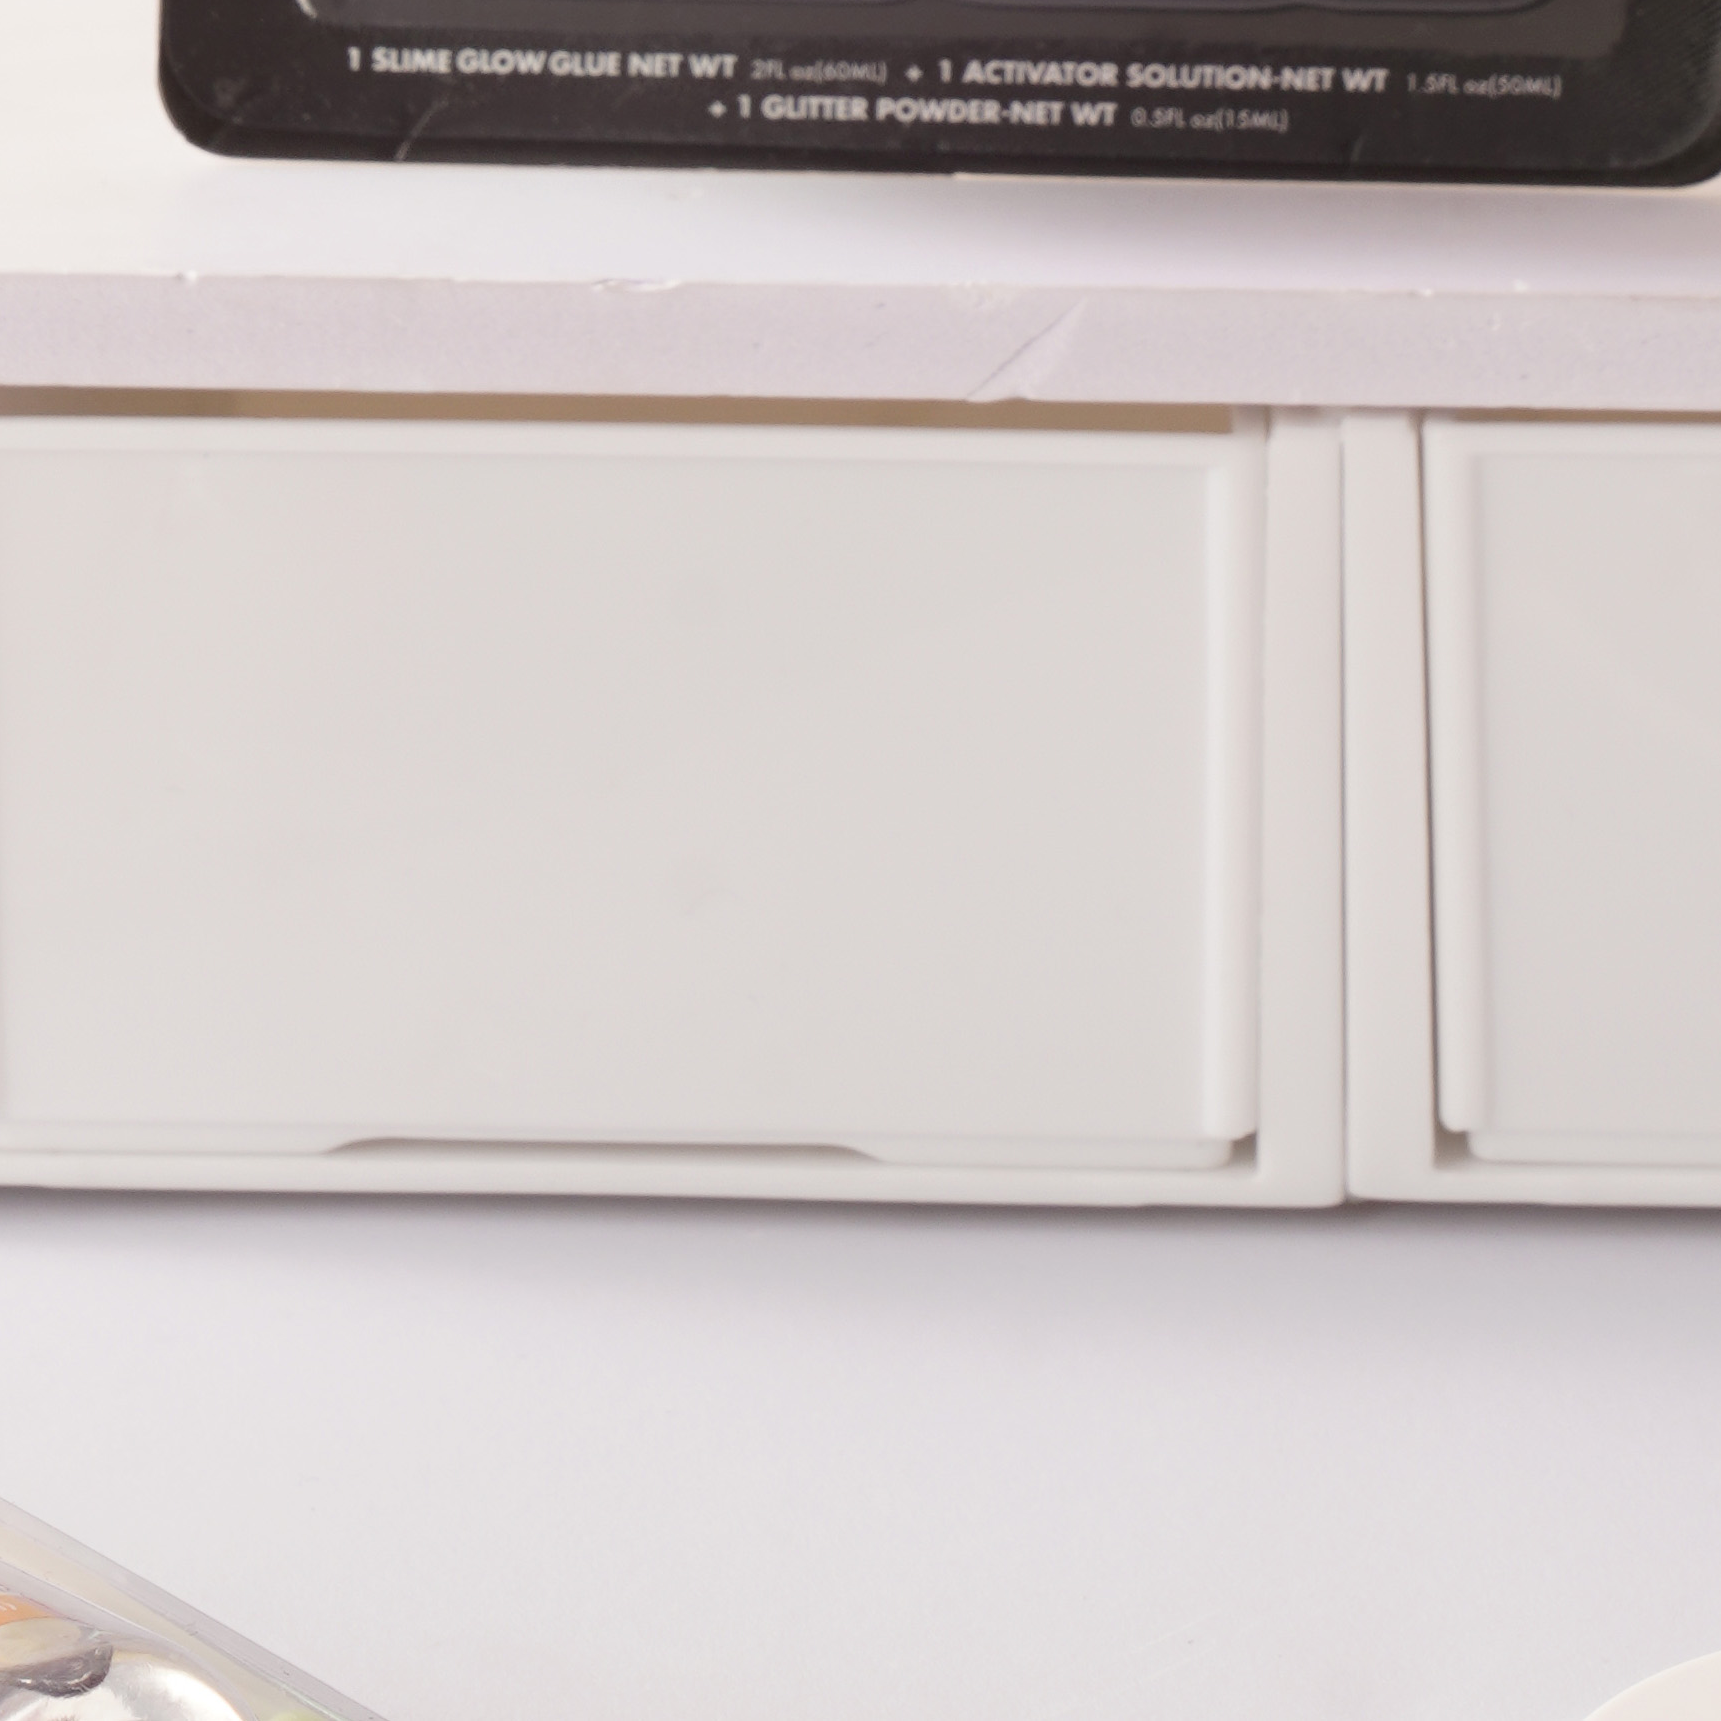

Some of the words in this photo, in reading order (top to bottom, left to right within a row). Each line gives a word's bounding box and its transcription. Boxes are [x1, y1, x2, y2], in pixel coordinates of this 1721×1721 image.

[347, 47, 360, 72] 1
[372, 47, 452, 74] SLIME
[456, 49, 546, 76] GLOW
[547, 50, 621, 77] GLUE
[627, 52, 684, 78] NET
[689, 54, 737, 79] WT
[939, 60, 952, 84] 1
[962, 60, 1119, 88] ACTIVATOR
[1340, 67, 1389, 94] WT
[737, 94, 751, 119] 1
[761, 95, 867, 122] GLITTER
[1070, 101, 1118, 127] WT
